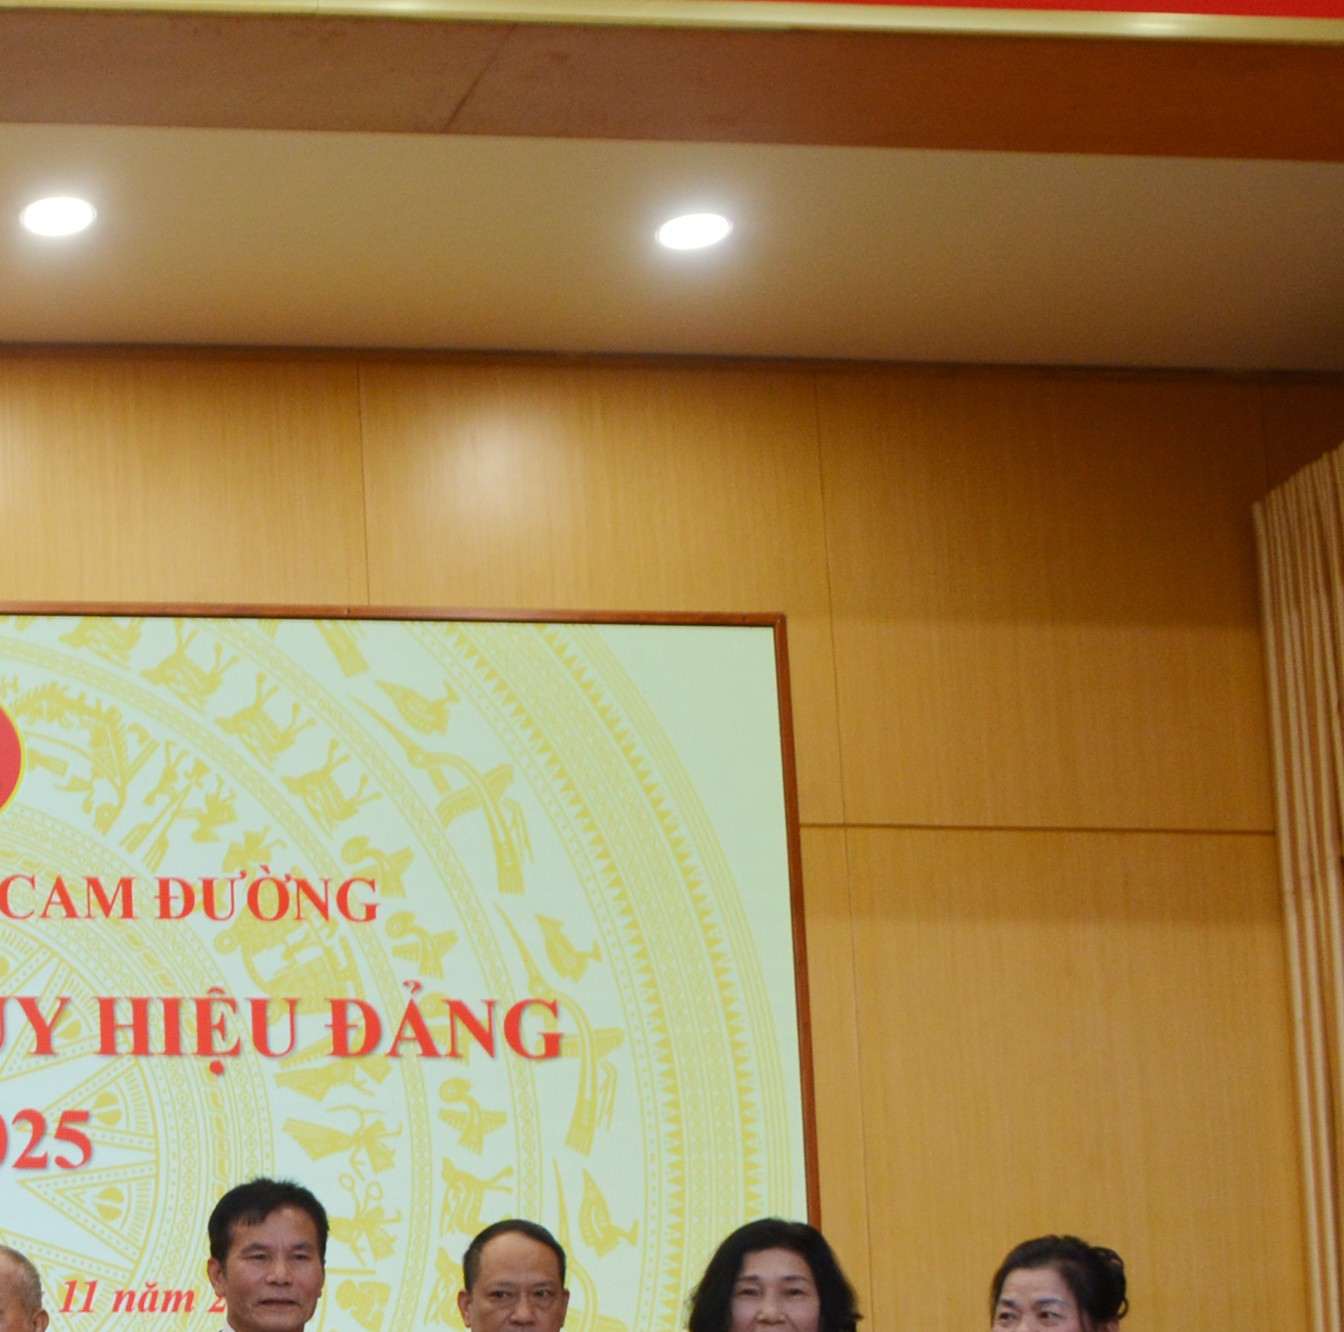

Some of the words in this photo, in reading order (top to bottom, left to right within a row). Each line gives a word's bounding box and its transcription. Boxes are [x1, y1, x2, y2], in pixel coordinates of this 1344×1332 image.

[153, 868, 380, 924] ĐƯỜNG
[98, 988, 299, 1076] HIỆU
[326, 980, 564, 1061] ĐẢNG
[59, 1279, 98, 1313] 11
[112, 1279, 197, 1314] năm
